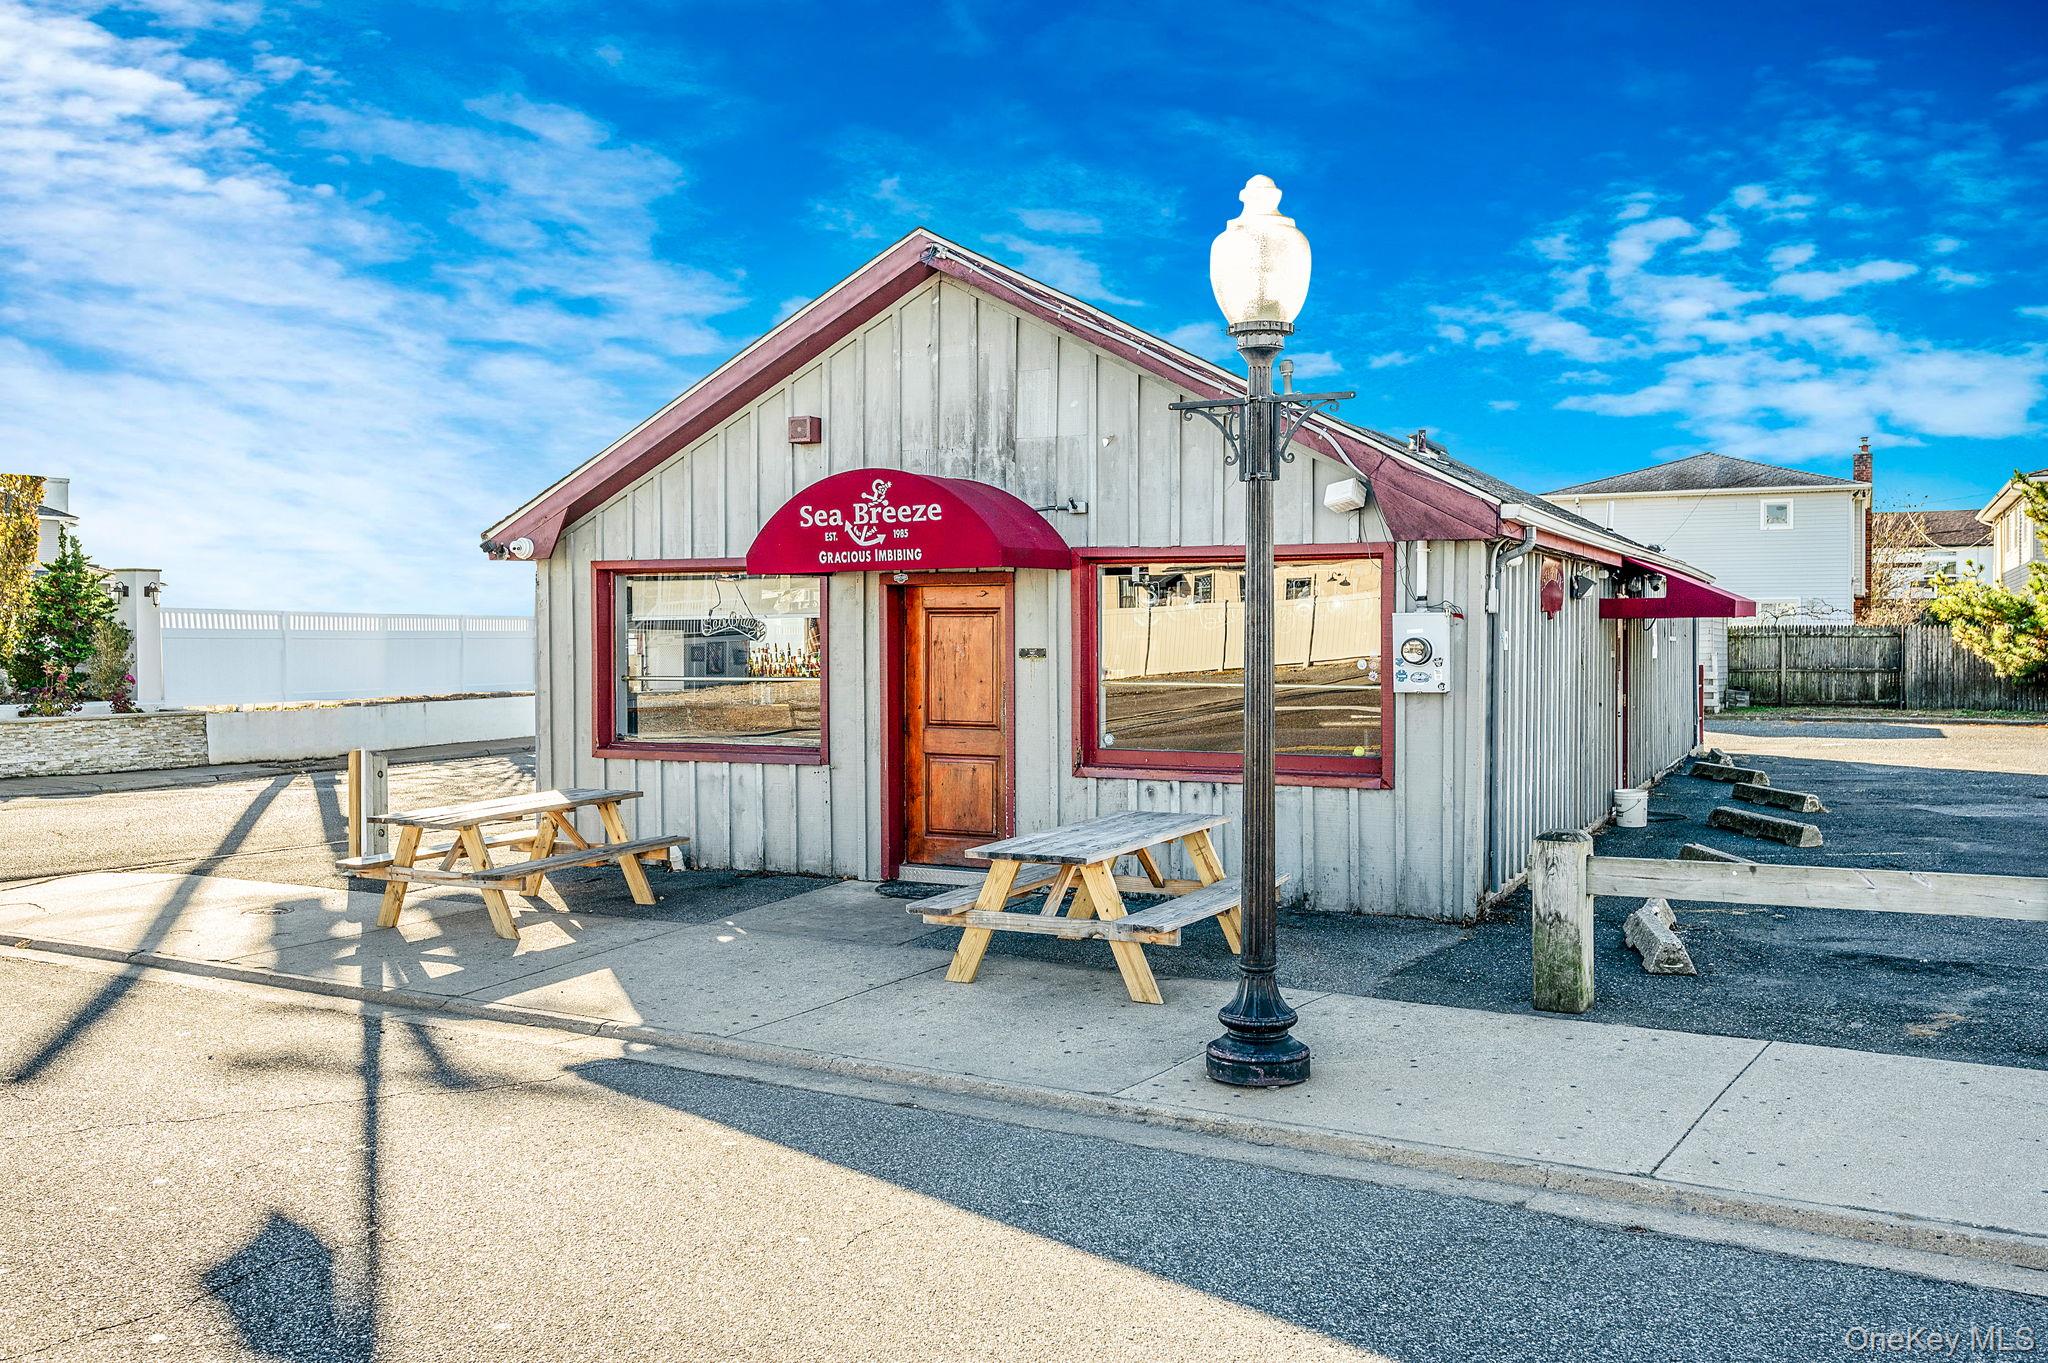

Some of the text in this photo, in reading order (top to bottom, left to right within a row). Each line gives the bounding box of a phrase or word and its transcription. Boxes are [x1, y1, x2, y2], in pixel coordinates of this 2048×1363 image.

[800, 503, 942, 527] Sea Breeze
[825, 529, 909, 541] EST. 1985
[819, 548, 922, 564] GRACIOUS IMBIBING
